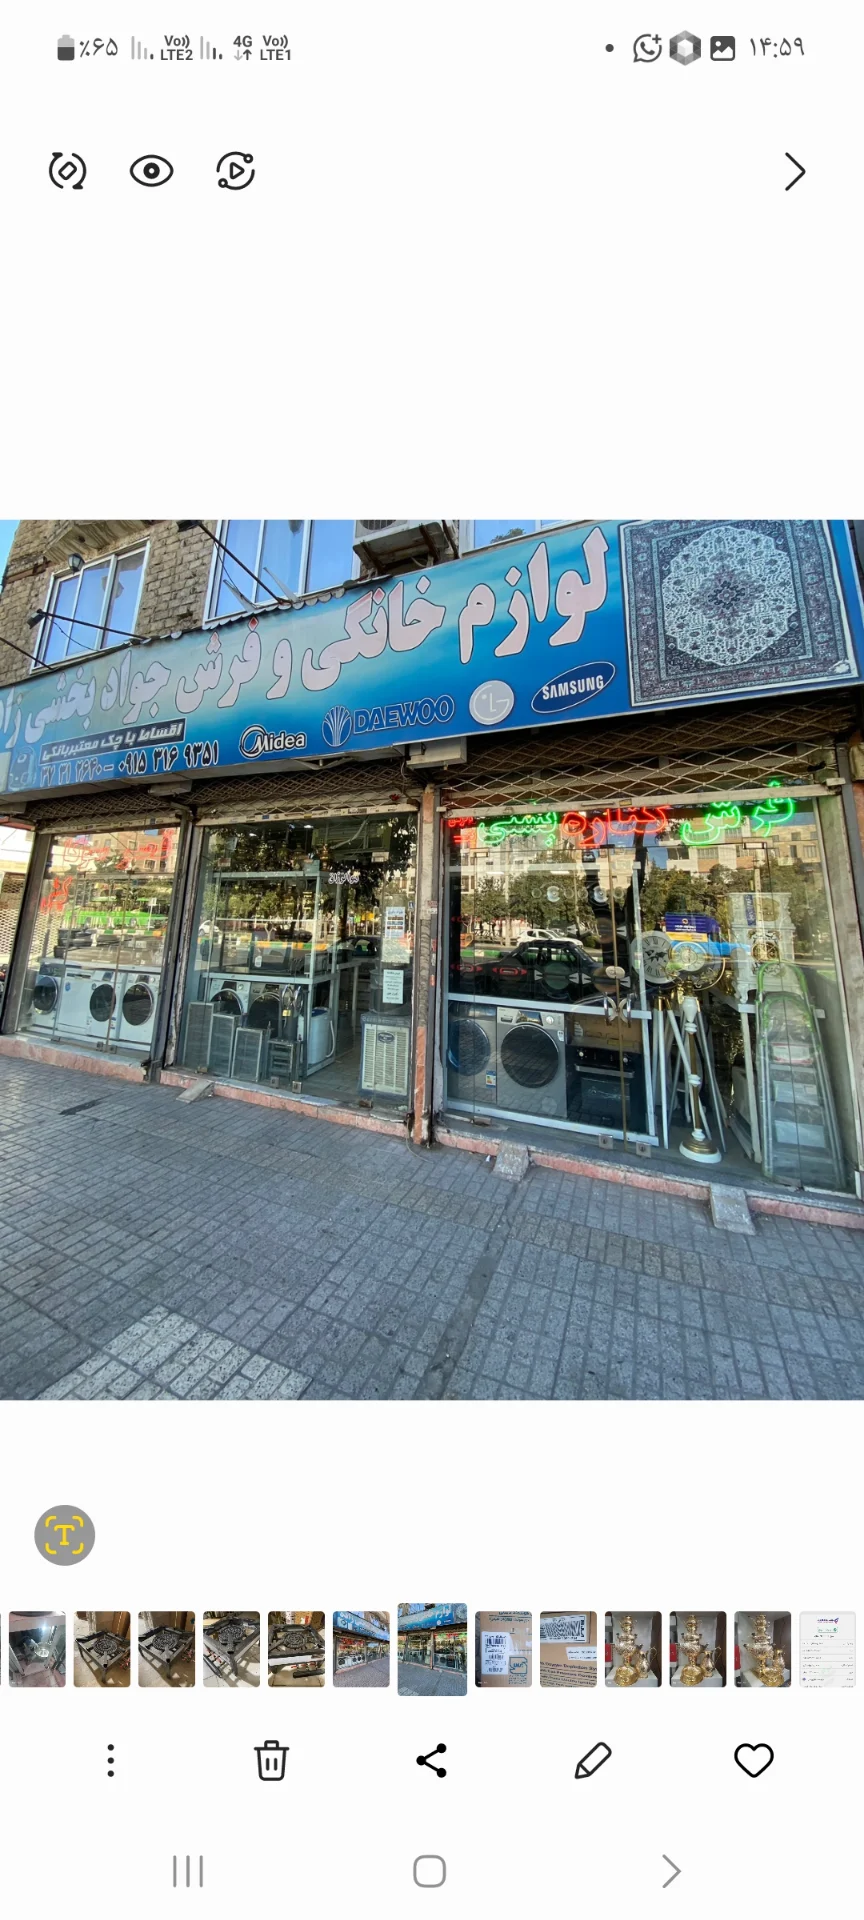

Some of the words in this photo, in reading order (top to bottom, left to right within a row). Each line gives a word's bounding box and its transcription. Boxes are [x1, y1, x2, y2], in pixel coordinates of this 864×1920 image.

[458, 526, 610, 664] لوازم
[302, 575, 446, 692] خانگی
[101, 650, 171, 725] جواد
[175, 616, 262, 713] فرش
[266, 638, 293, 700] و
[541, 674, 604, 700] SAMSUNG
[25, 666, 97, 743] بخشی
[353, 694, 455, 735] DAEWOO
[100, 734, 123, 751] چک
[124, 731, 136, 746] با
[137, 722, 183, 742] اقساط
[152, 745, 179, 772] ۳۱۶
[183, 739, 219, 768] ۹۳۵۱
[254, 729, 306, 753] Midea
[680, 780, 795, 845] فرش
